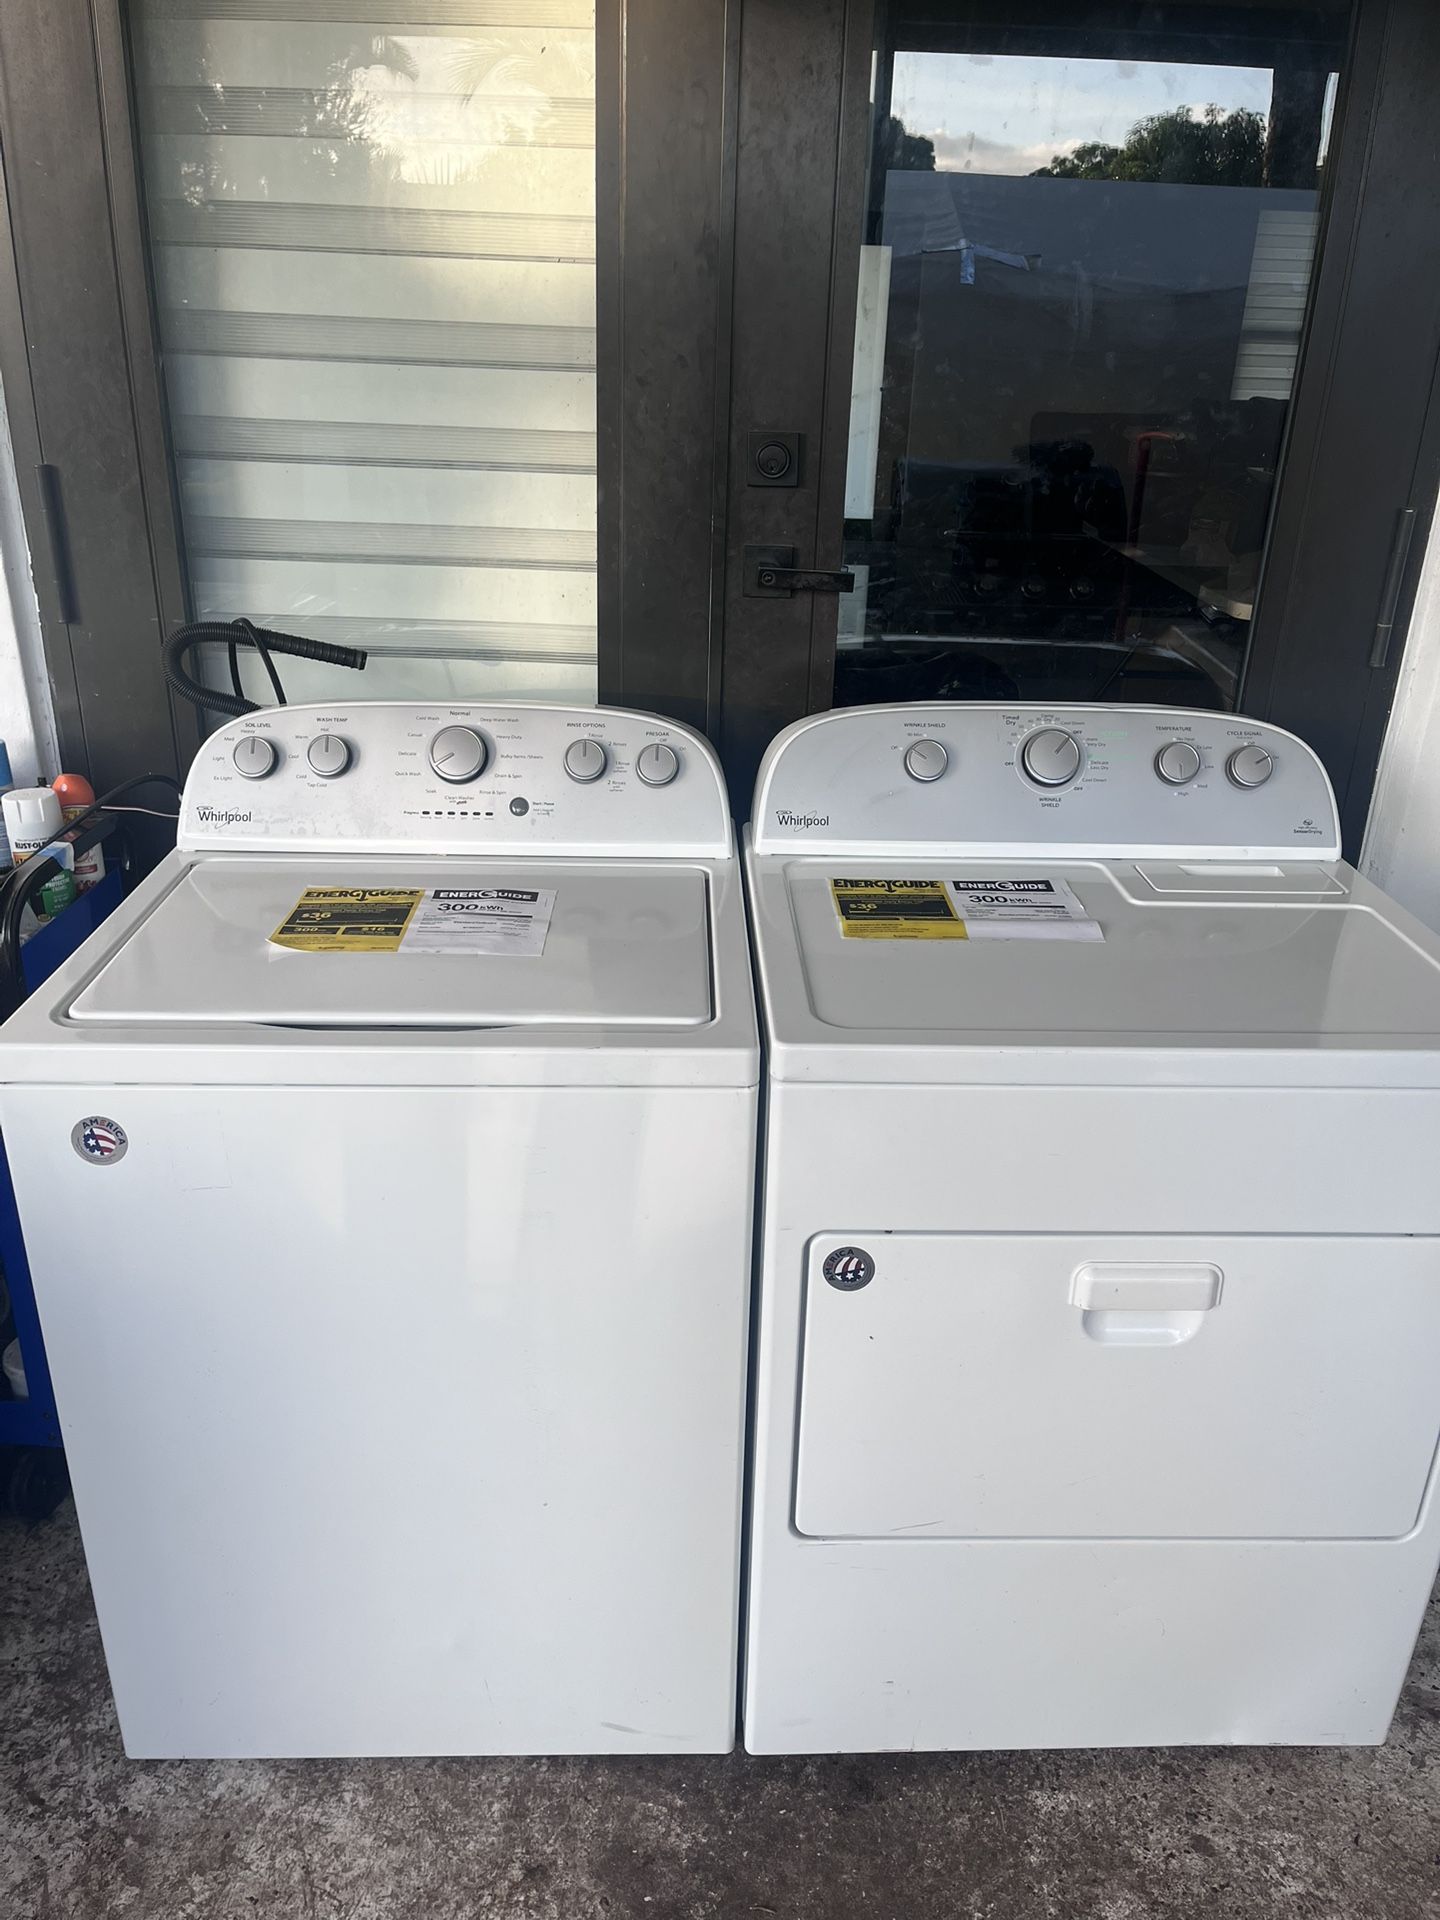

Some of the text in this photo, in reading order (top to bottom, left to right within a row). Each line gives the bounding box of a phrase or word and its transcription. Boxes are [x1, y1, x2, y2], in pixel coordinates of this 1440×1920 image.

[198, 811, 252, 824] Whirlpool
[778, 815, 829, 828] Whirlpool
[833, 879, 941, 893] ENERGYGUIDE
[958, 880, 1048, 891] ENERGUIDE
[304, 889, 420, 901] ENERGYGUIDE
[439, 889, 533, 900] ENERGUIDE
[968, 895, 1008, 903] 300
[437, 903, 480, 911] 300
[82, 1118, 126, 1145] AMERICA
[825, 1248, 855, 1280] AMERICA
